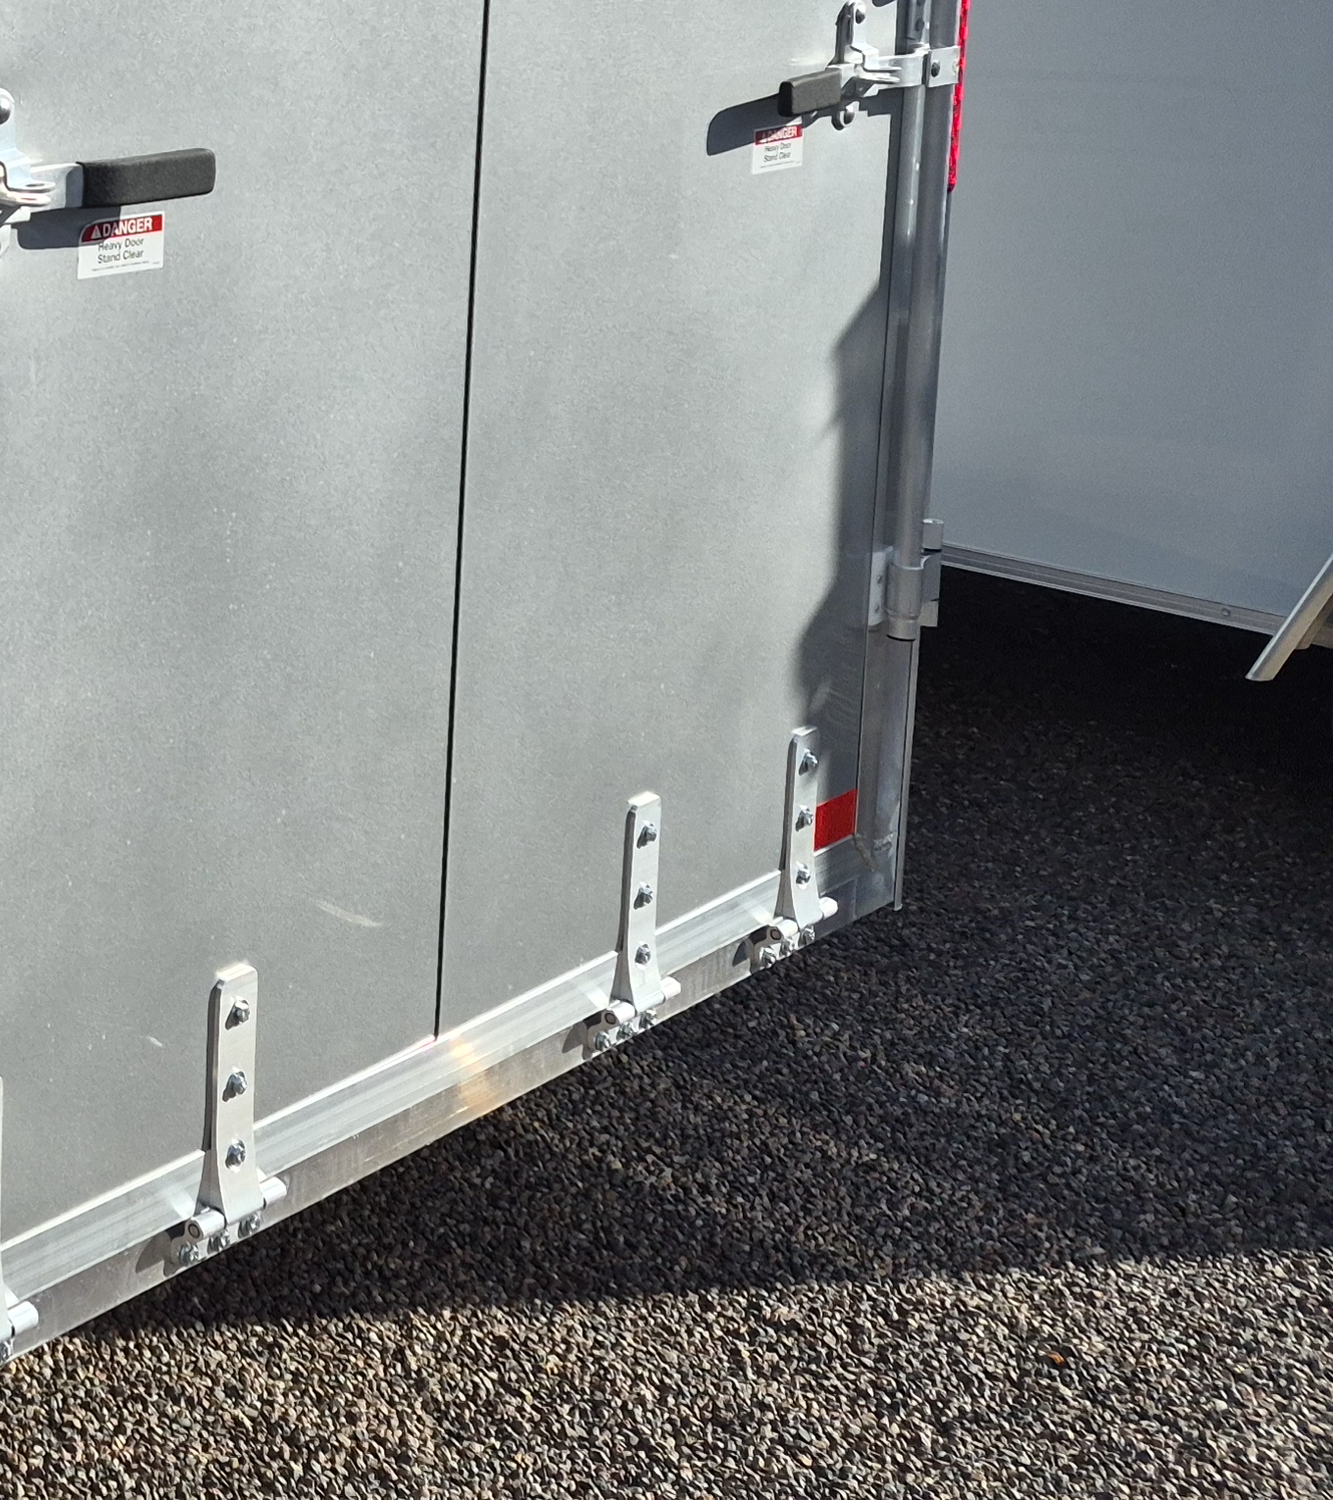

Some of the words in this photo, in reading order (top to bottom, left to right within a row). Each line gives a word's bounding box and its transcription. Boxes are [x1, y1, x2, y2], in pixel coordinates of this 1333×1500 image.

[102, 217, 153, 237] DANGER
[98, 240, 122, 252] Heavy
[124, 238, 145, 248] Door
[97, 252, 121, 264] Stand
[123, 250, 144, 260] Clear
